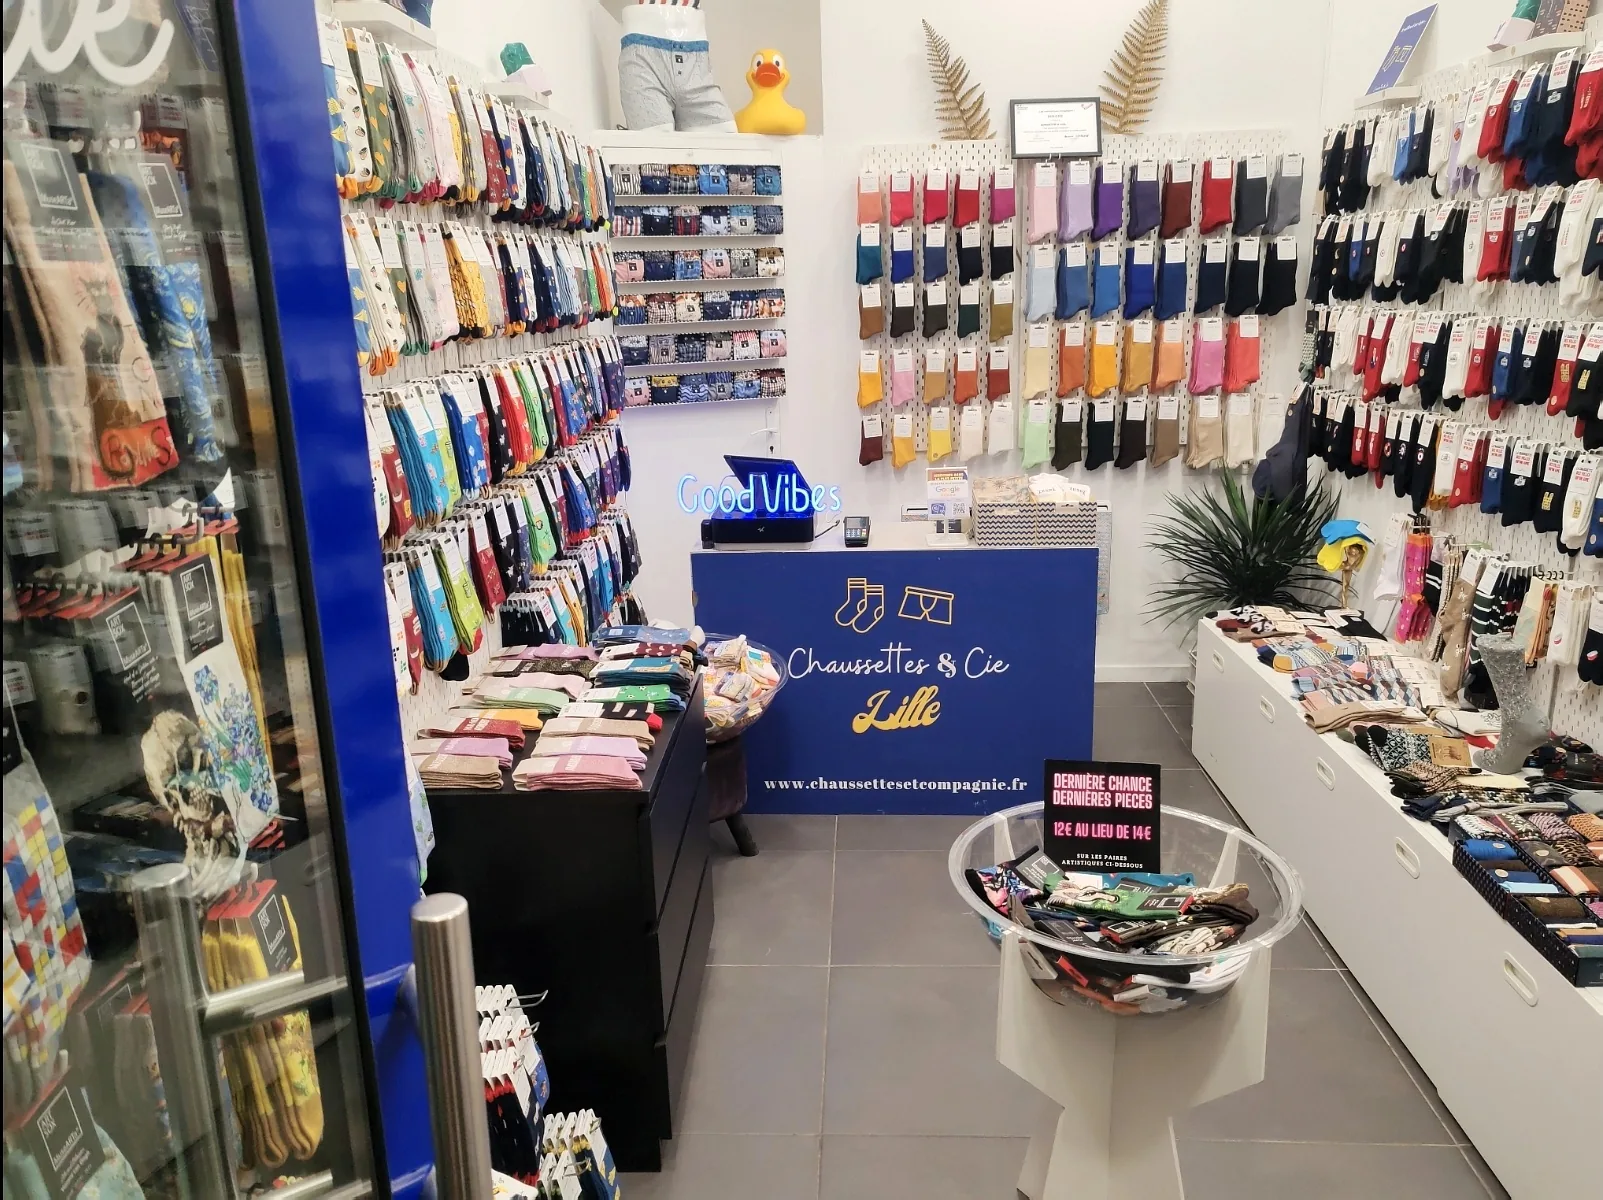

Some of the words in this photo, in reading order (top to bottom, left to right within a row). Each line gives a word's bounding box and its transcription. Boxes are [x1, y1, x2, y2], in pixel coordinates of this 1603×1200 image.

[678, 474, 755, 513] Good
[761, 473, 841, 512] Vibes
[935, 485, 961, 494] Google
[788, 642, 929, 679] Chaussettes
[937, 652, 957, 678] &
[964, 647, 1010, 679] Cie
[852, 685, 941, 734] Lille
[764, 776, 1028, 793] www.chaussettesetcompagnie.fr
[1053, 772, 1105, 790] DERNIÈRE
[1109, 775, 1152, 792] CHANCE
[1053, 790, 1111, 807] DERNIÈRES
[1115, 793, 1152, 809] PIECES
[1054, 822, 1072, 836] 12€
[1075, 823, 1088, 837] AU
[1092, 823, 1113, 838] LIEU
[1116, 825, 1129, 839] DE
[1133, 826, 1151, 840] 14€
[1105, 861, 1143, 869] CI-DESSOUS
